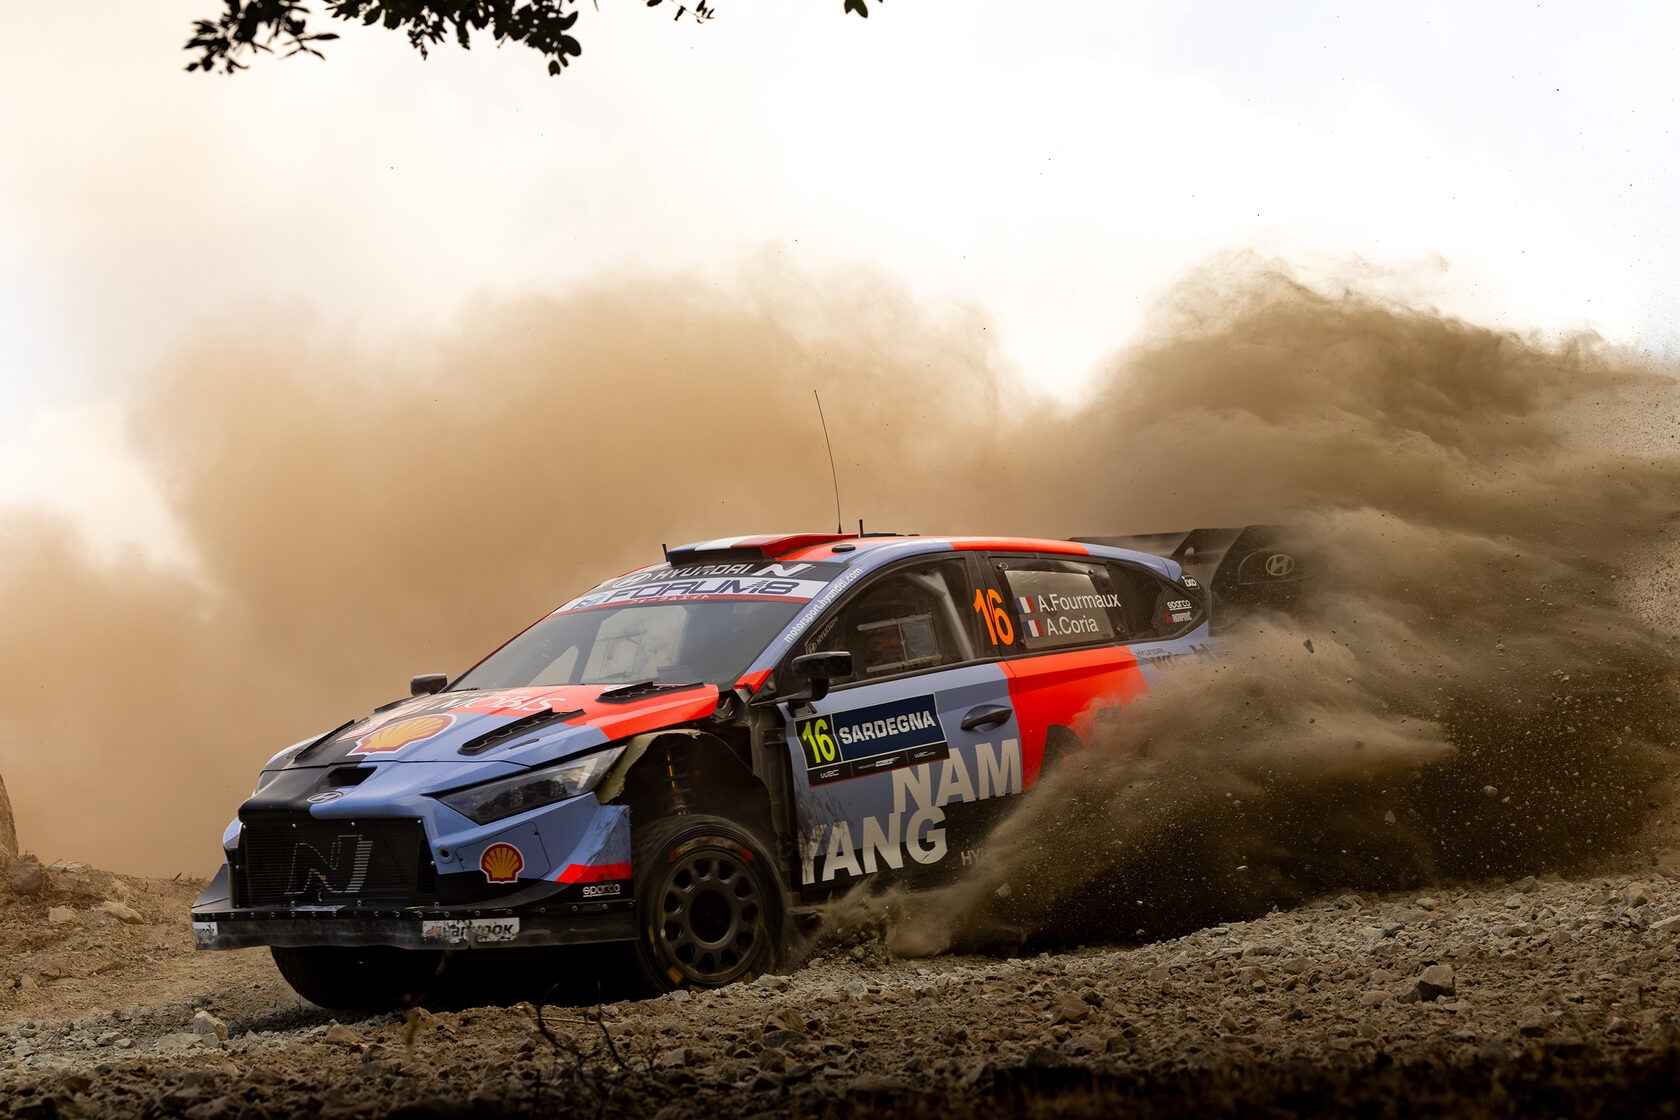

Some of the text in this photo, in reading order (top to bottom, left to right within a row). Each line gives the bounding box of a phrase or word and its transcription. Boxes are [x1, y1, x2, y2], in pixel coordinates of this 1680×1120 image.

[651, 563, 754, 581] HYUNDAI
[784, 568, 864, 643] motorsport.hyundai.com
[973, 588, 1014, 646] 16
[1037, 593, 1121, 613] A.Fourmaux
[1167, 600, 1192, 611] sparco
[1046, 617, 1099, 636] A.Coria
[802, 710, 936, 764] 16 SARDEGNA
[892, 738, 1023, 813] NAM
